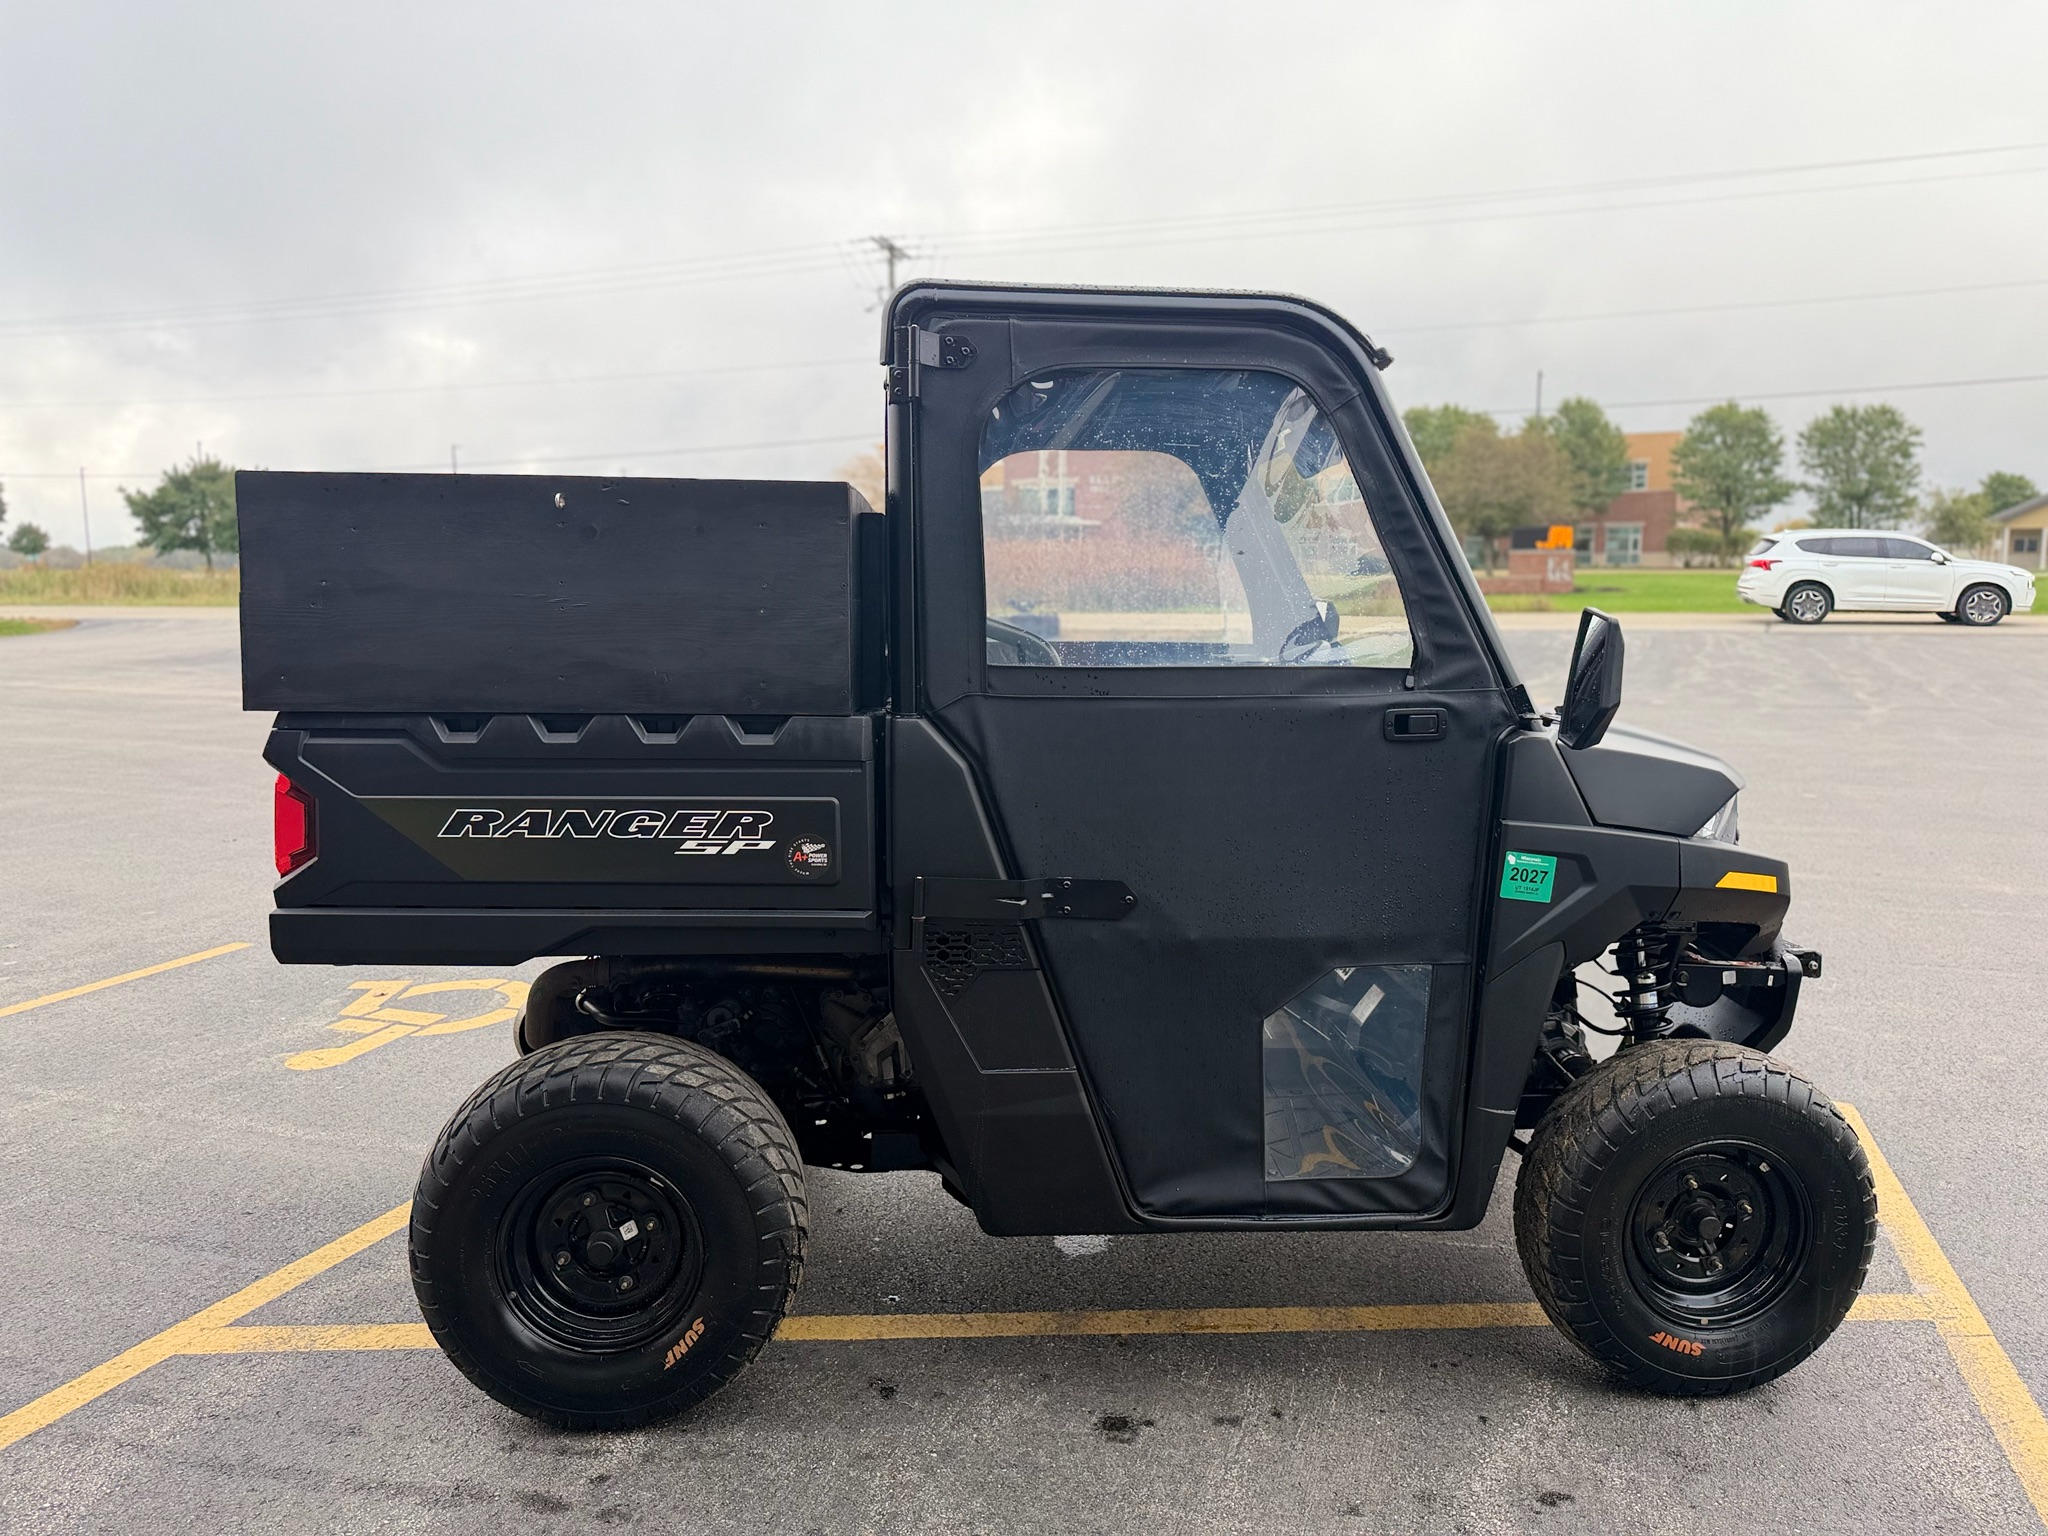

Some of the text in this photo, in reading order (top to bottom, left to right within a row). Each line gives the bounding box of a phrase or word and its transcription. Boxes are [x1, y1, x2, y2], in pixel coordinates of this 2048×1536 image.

[437, 808, 774, 839] RANGER
[673, 840, 777, 855] SP
[793, 851, 808, 862] A+
[1509, 866, 1549, 884] 2027
[663, 1316, 705, 1371] SUNF
[1647, 1331, 1707, 1357] SUNF
